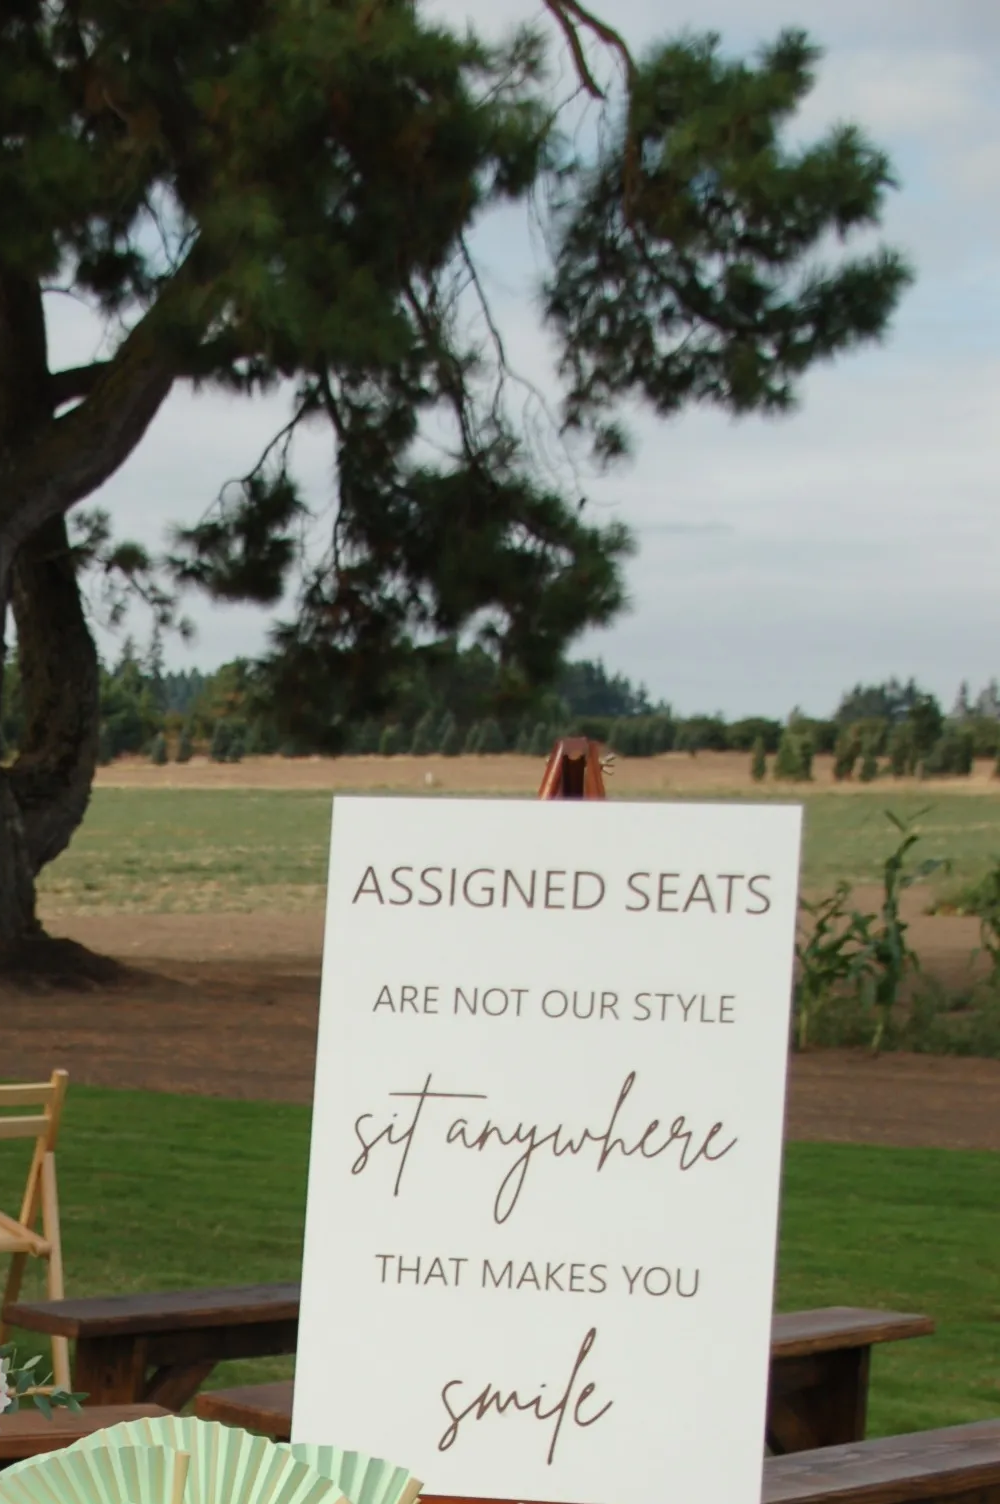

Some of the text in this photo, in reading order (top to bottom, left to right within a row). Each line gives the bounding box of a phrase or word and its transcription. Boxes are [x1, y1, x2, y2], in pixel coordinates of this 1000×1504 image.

[352, 864, 772, 916] ASSIGNED SEATS
[371, 984, 736, 1024] ARE NOT OUR STYLE
[351, 1070, 738, 1225] sit anywhere
[374, 1253, 700, 1299] THAT MAKES YOU
[438, 1327, 614, 1466] smile
